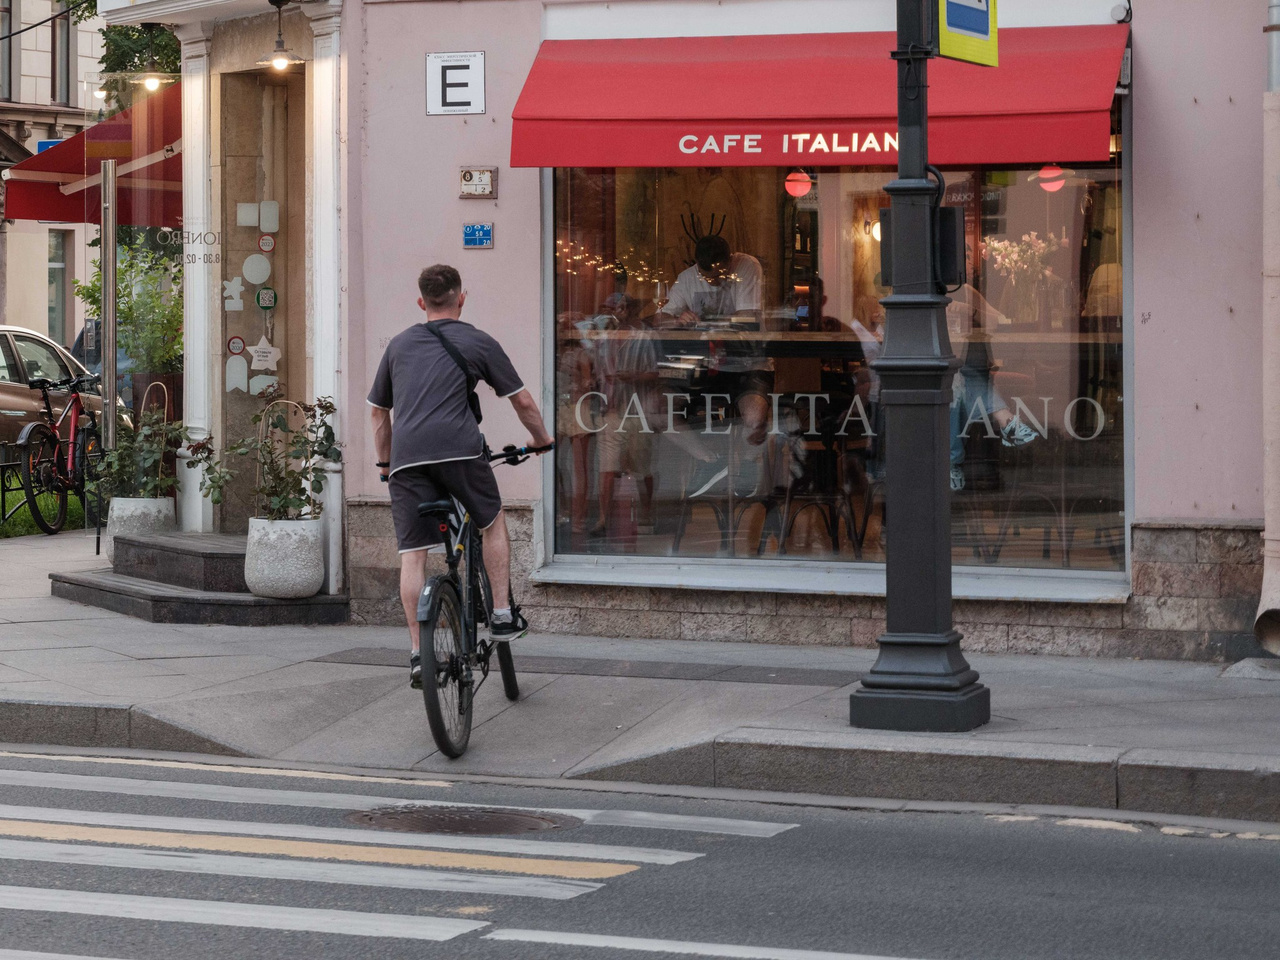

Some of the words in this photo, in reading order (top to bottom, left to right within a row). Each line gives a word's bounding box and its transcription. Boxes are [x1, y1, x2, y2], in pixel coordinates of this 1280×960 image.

[678, 134, 762, 154] CAFE
[782, 132, 898, 153] ITALIAN
[574, 391, 733, 435] CAFE
[766, 392, 1106, 441] ITAANO
